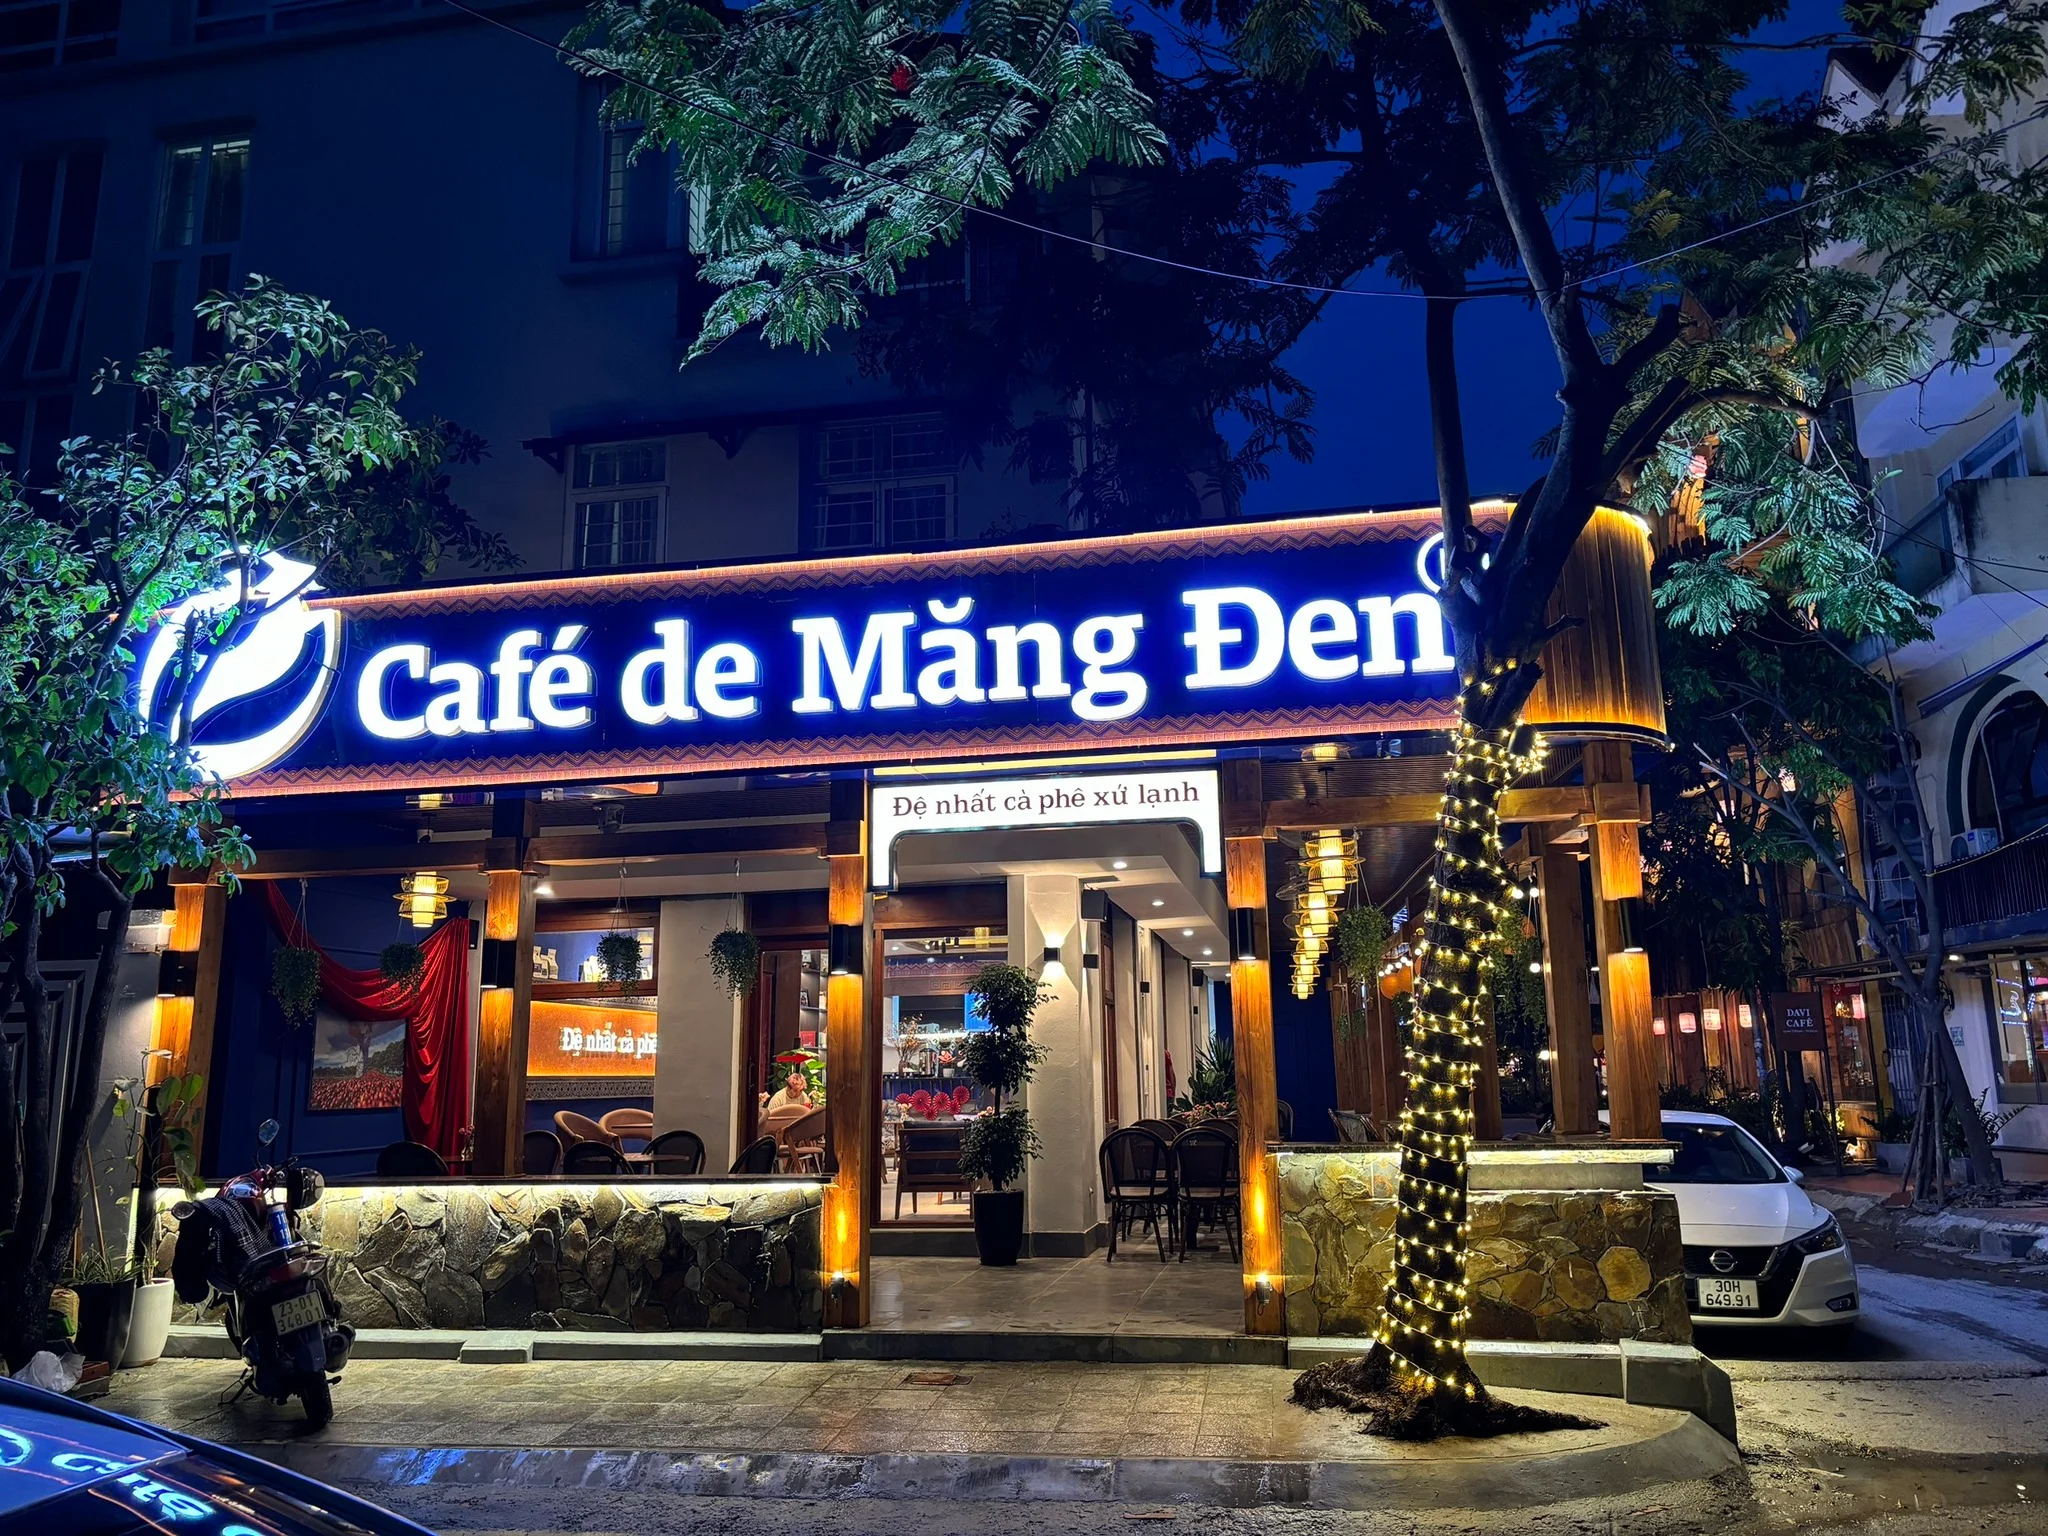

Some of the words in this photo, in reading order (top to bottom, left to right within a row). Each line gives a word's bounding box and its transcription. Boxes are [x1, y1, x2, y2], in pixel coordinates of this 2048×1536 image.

[357, 625, 595, 739] Café
[621, 619, 761, 726] de
[791, 596, 1149, 722] Măng
[1182, 585, 1456, 690] Đen
[893, 796, 927, 819] Đệ
[936, 788, 996, 815] nhất
[1004, 789, 1031, 811] cà
[1038, 787, 1086, 815] phê
[1094, 783, 1129, 807] xứ
[1138, 781, 1200, 808] lạnh
[1785, 1017, 1814, 1028] CAFÉ
[1786, 1008, 1811, 1017] DAVI
[559, 1027, 583, 1056] Đệ
[585, 1022, 618, 1052] nhất
[1715, 1280, 1741, 1293] 30H
[1705, 1293, 1752, 1307] 649.91
[277, 1306, 322, 1333] 348.01
